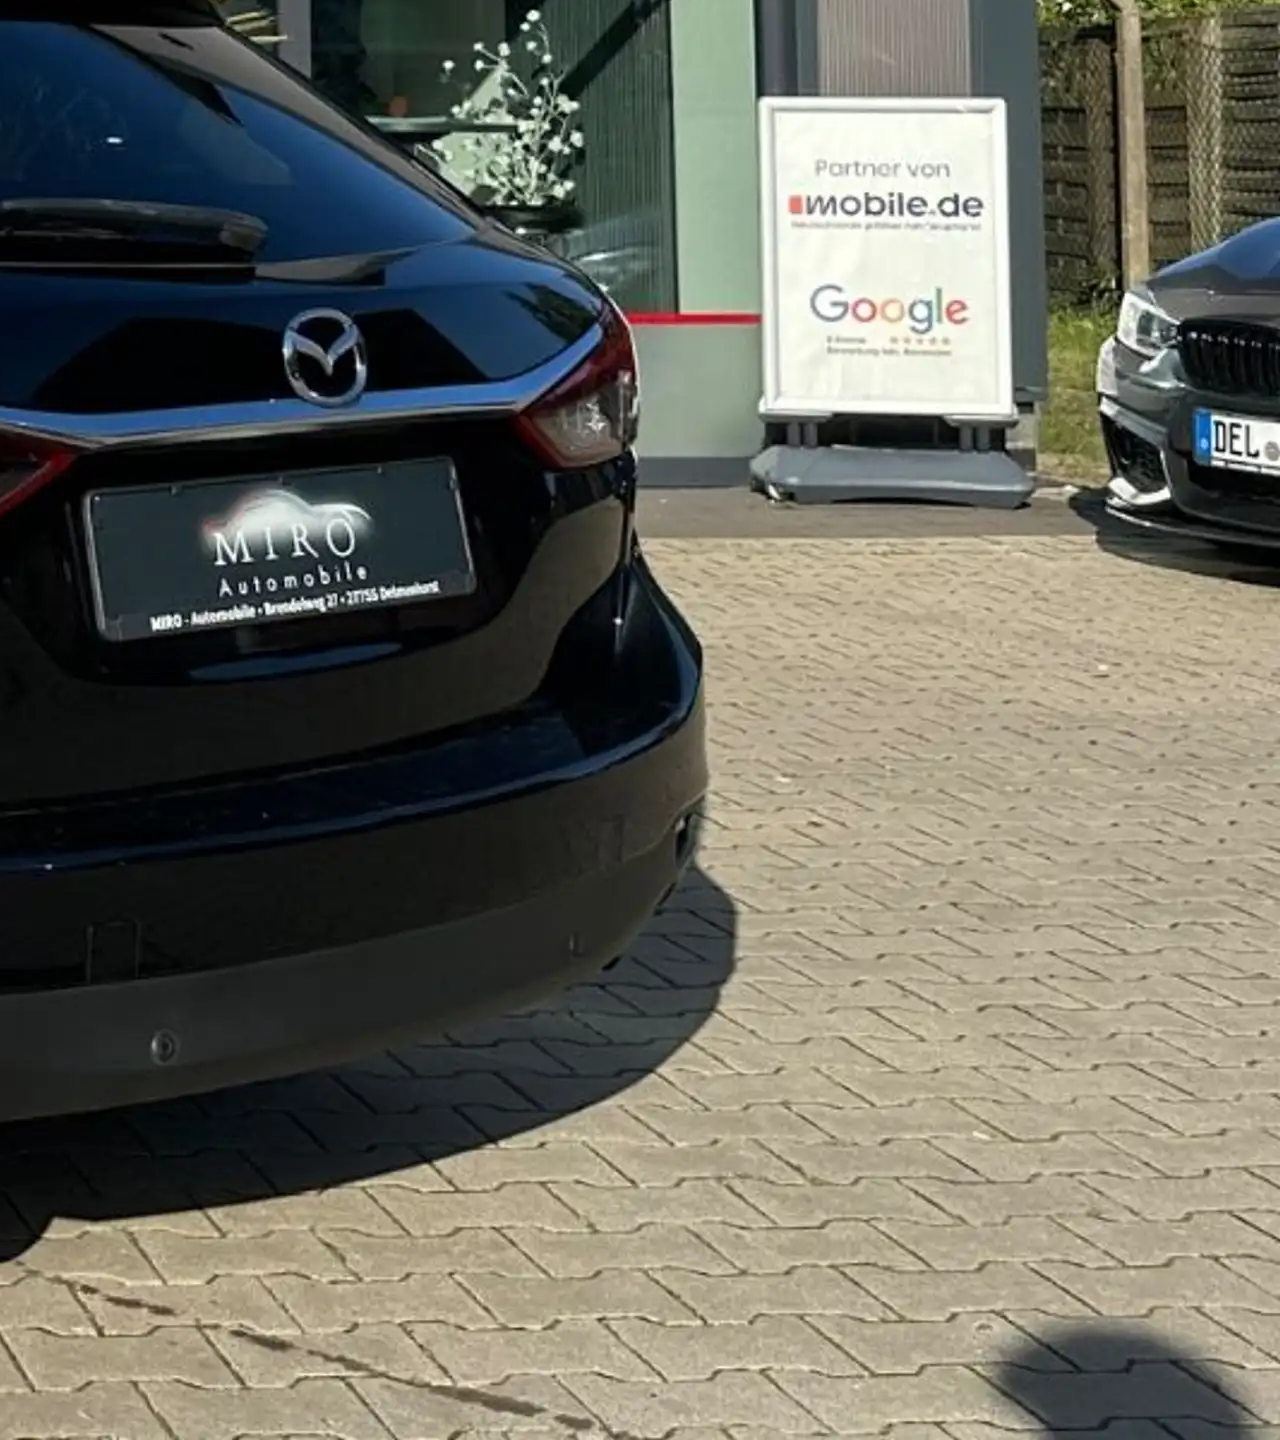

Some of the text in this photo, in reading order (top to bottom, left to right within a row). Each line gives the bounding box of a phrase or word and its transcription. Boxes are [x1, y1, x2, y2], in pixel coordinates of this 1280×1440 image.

[814, 159, 950, 178] Partner von
[805, 192, 984, 217] mobile.de
[809, 284, 969, 335] Google
[1215, 421, 1259, 457] DEL
[214, 517, 355, 566] MIRO
[219, 561, 369, 597] Automobile
[149, 614, 182, 632] MIRO
